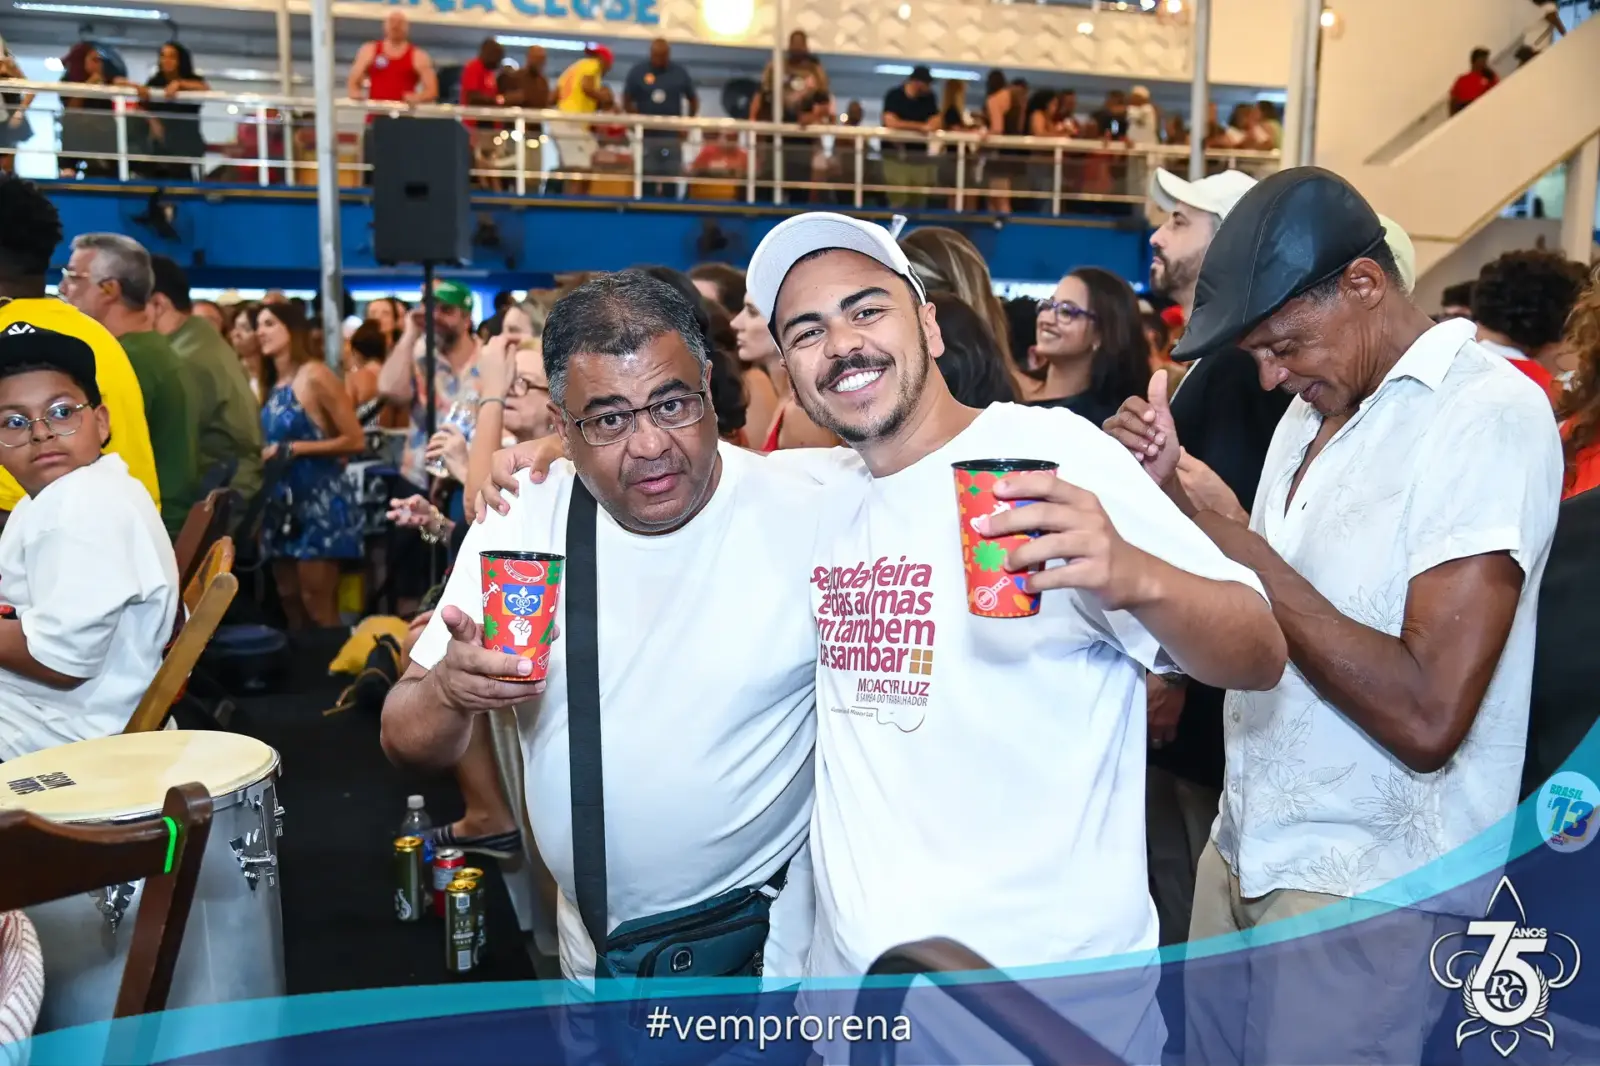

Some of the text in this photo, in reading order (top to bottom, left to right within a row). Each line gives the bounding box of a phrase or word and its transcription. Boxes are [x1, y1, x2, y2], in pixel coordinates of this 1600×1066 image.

[830, 641, 910, 673] sambar
[857, 678, 930, 697] MOACYR LUZ
[1550, 784, 1583, 800] BRASIL
[1551, 797, 1594, 837] 13
